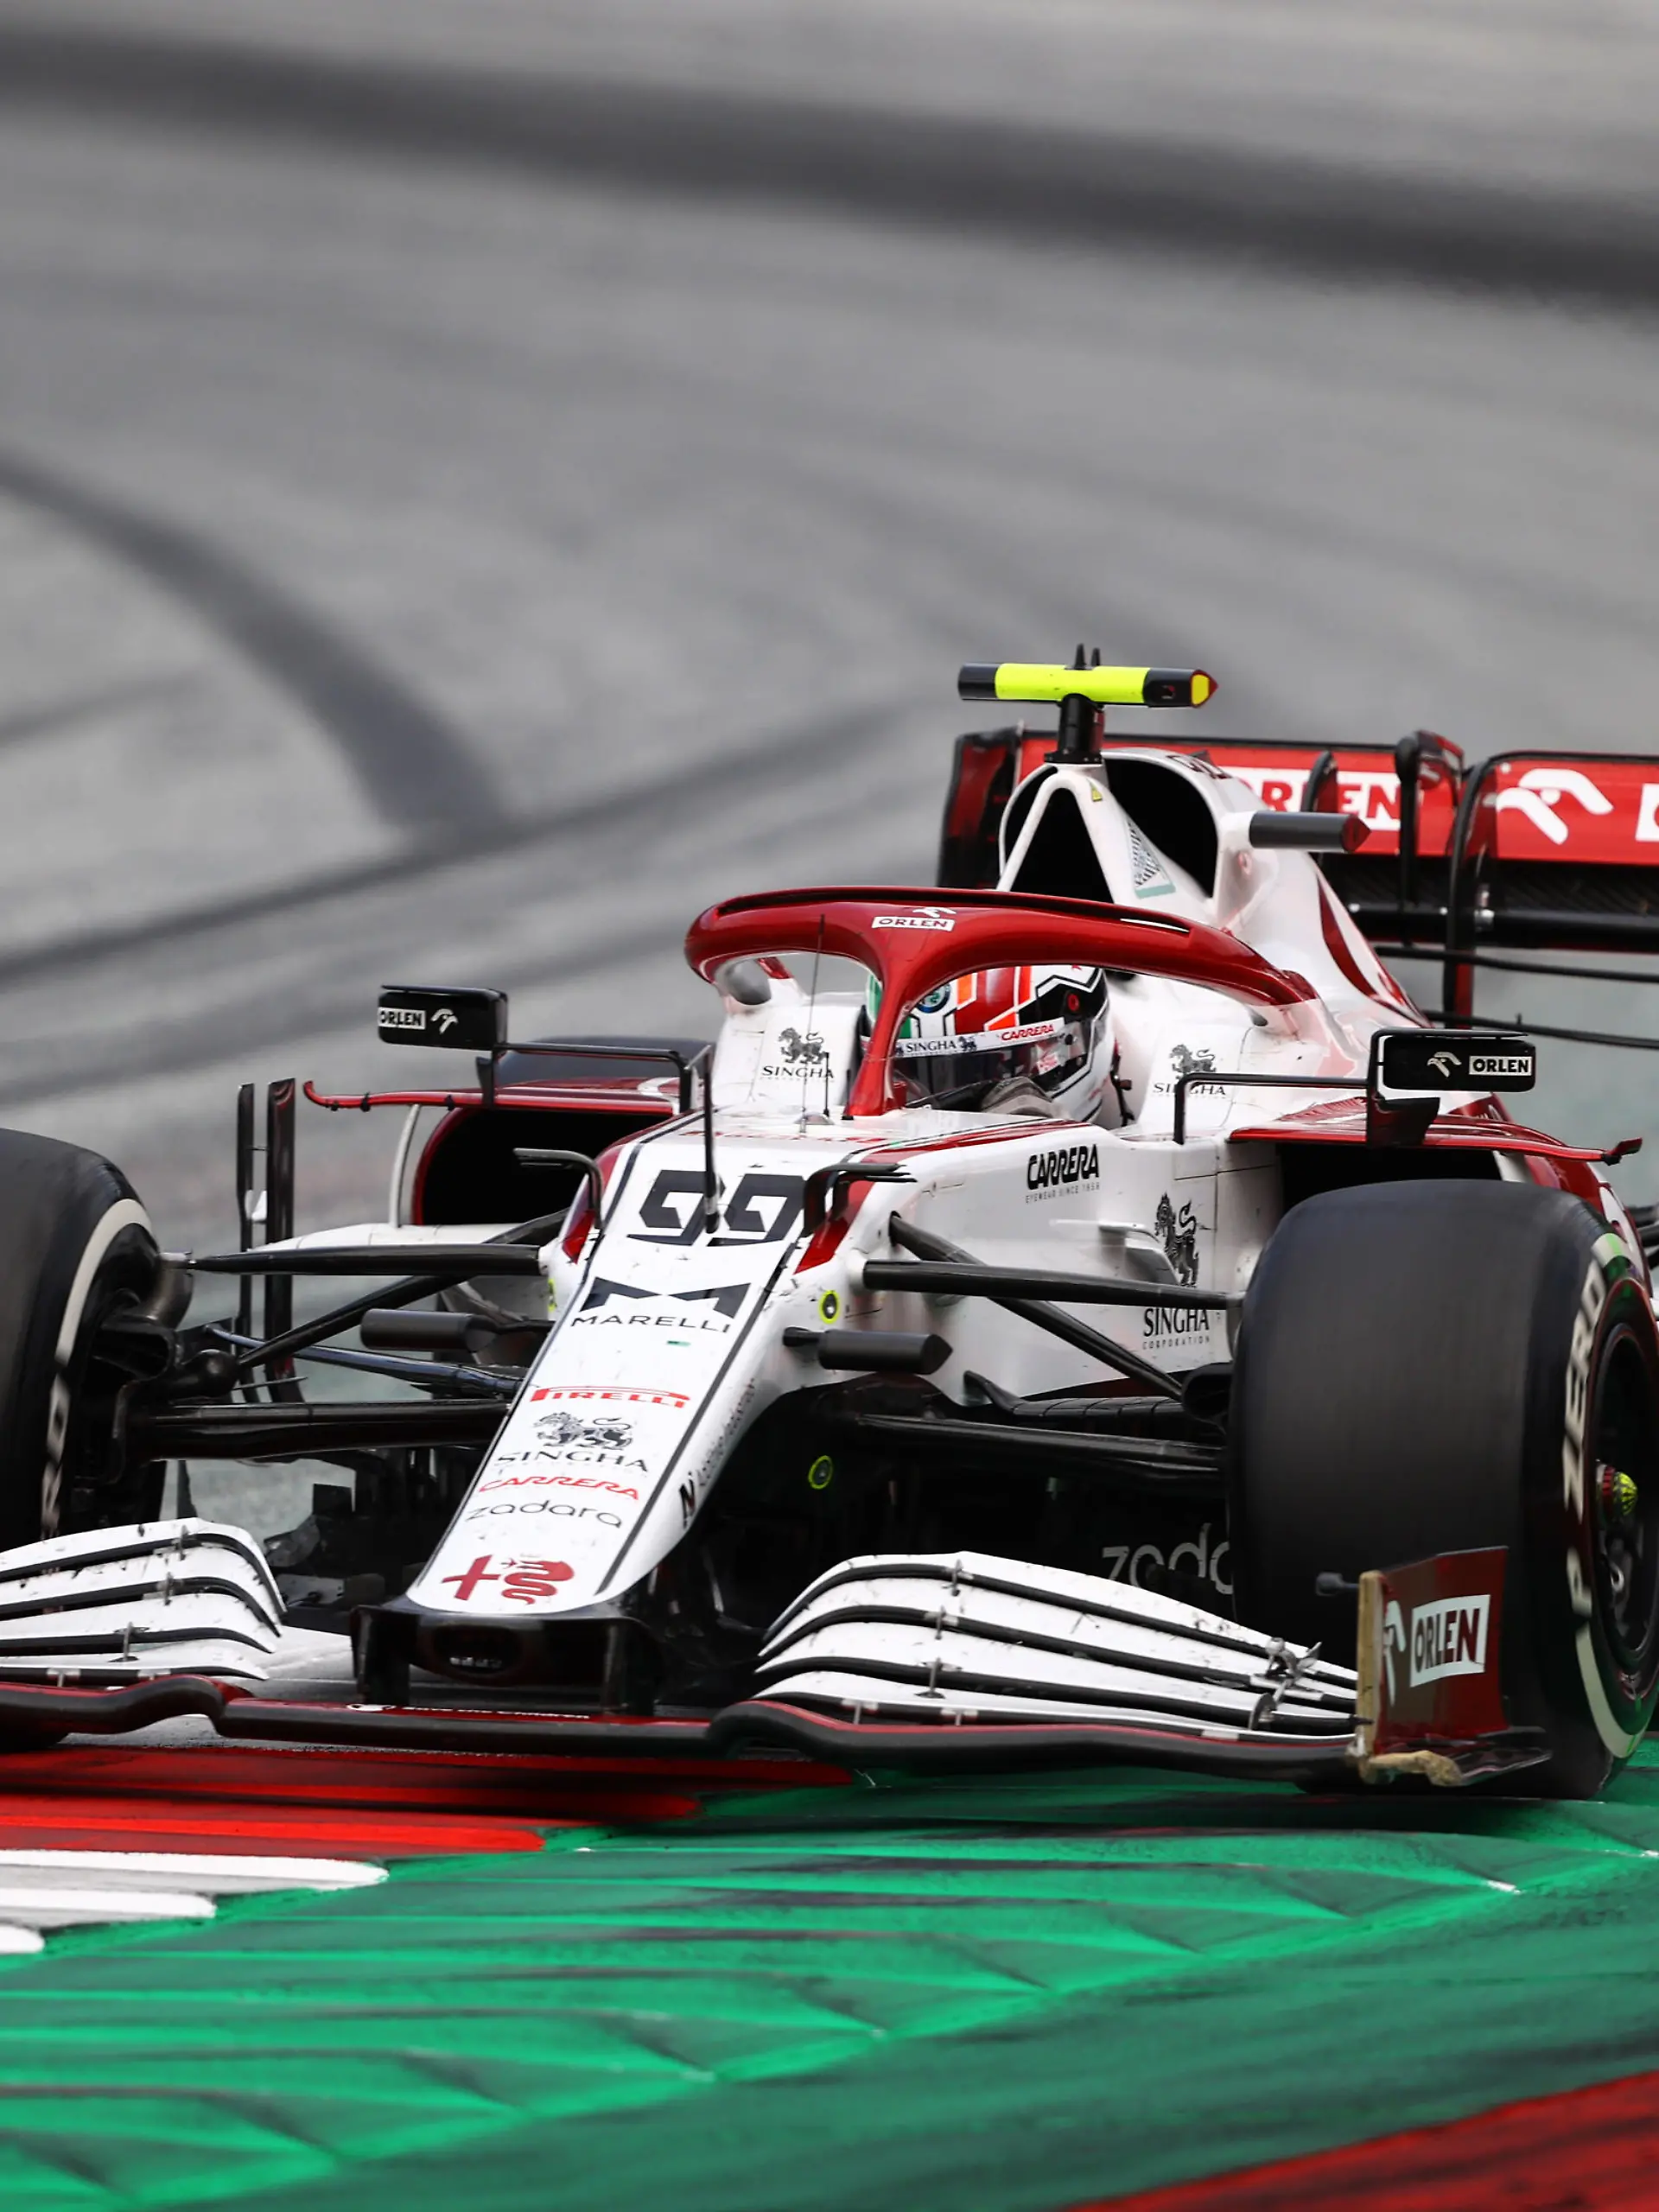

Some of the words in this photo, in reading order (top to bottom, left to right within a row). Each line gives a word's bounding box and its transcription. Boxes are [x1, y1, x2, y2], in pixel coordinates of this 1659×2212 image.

[879, 918, 947, 928] ORLEN
[1001, 1025, 1054, 1041] CARRERA
[906, 1039, 957, 1052] SINGHA
[762, 1065, 834, 1078] SINGHA
[1472, 1058, 1529, 1073] ORLEN
[1027, 1143, 1099, 1191] CARRERA
[626, 1169, 808, 1248] 99
[570, 1315, 731, 1333] MARELLI
[1143, 1306, 1210, 1337] SINGHA
[530, 1386, 690, 1408] PIRELLI
[1562, 1260, 1608, 1524] ZERO
[496, 1451, 648, 1472] SINGHA
[479, 1476, 639, 1500] CARRERA
[466, 1499, 622, 1529] zadara
[1414, 1608, 1480, 1674] ORLEN
